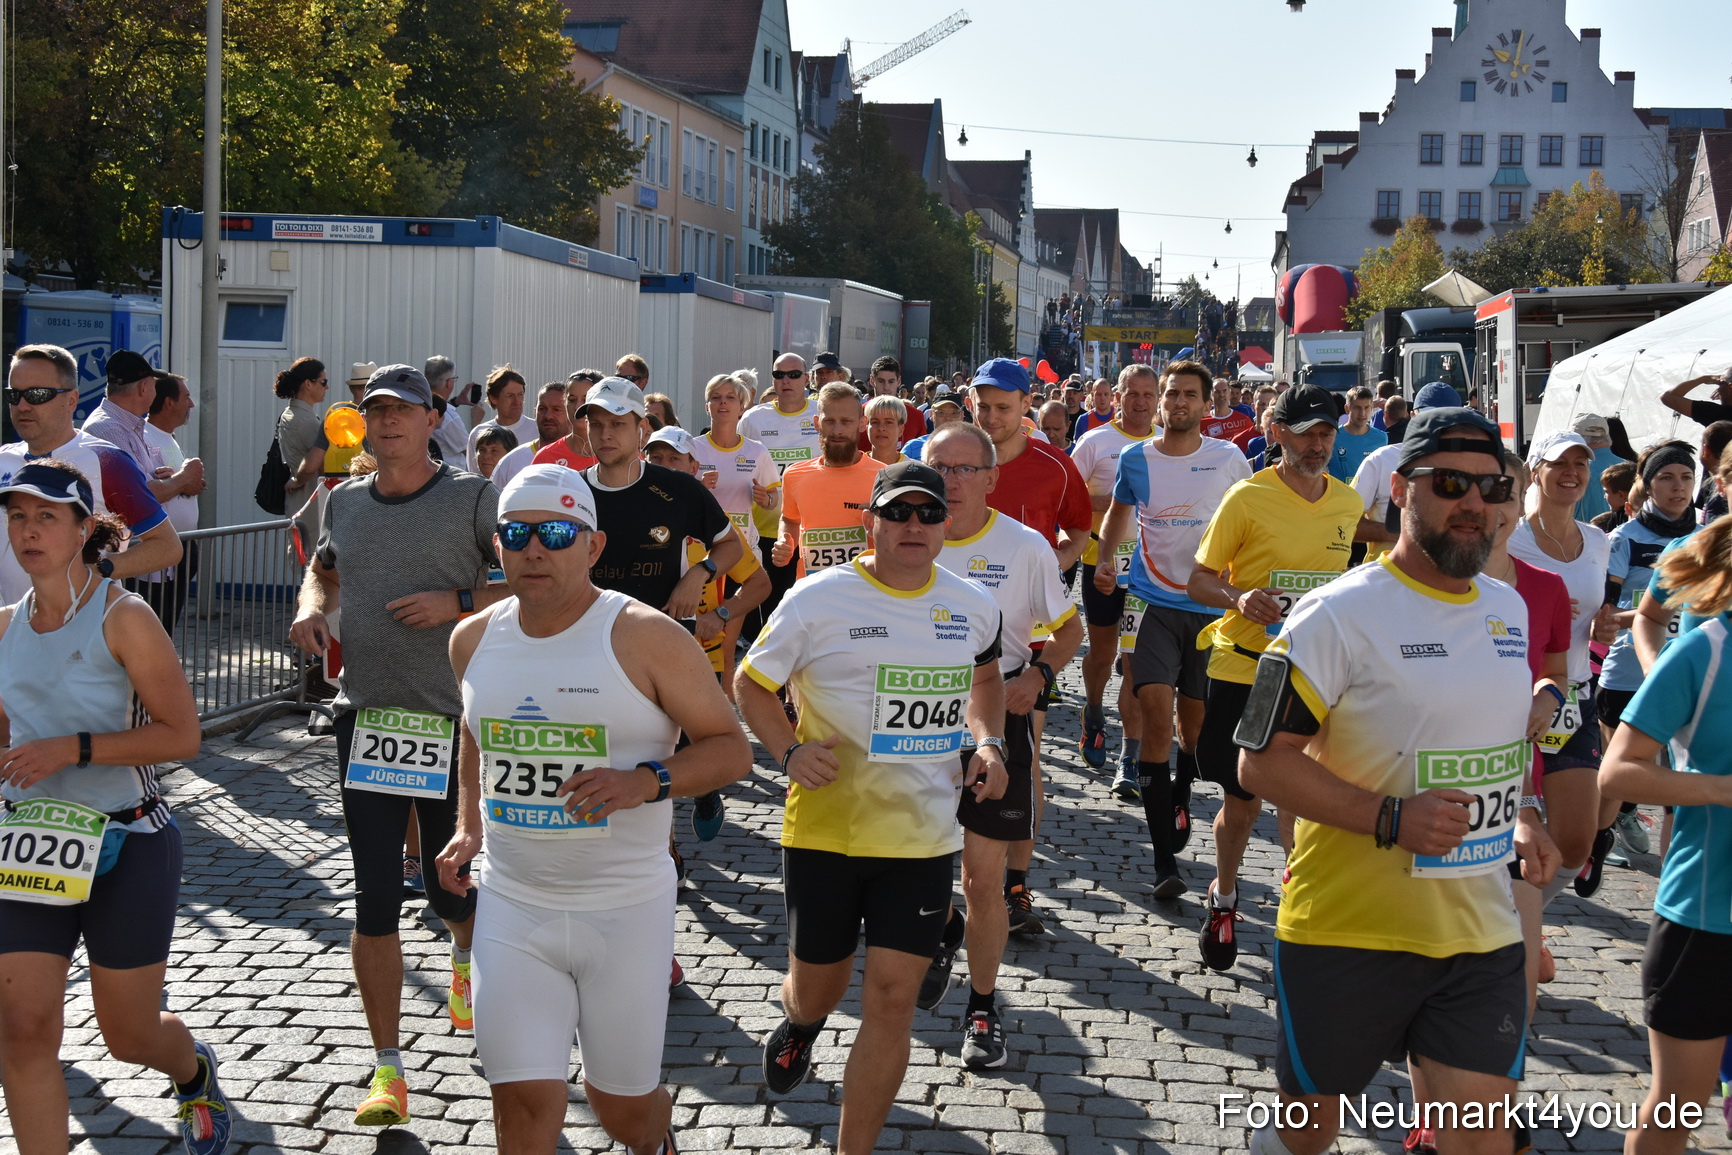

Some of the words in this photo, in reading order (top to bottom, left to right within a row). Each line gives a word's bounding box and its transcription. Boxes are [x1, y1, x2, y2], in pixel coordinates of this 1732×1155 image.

[47, 317, 71, 327] 08141
[77, 318, 92, 328] 536
[93, 319, 104, 329] 80
[1120, 330, 1160, 340] START
[843, 502, 859, 510] THU
[1171, 518, 1203, 528] Energie
[806, 528, 862, 545] BOCK
[630, 562, 663, 577] 2011
[969, 559, 987, 570] 20
[968, 571, 1009, 580] Neumarkter
[932, 608, 951, 622] 20
[849, 626, 889, 636] BOCK
[1487, 620, 1508, 636] 20
[935, 632, 967, 642] Stadtlauf
[1400, 643, 1448, 655] BOCK
[884, 667, 969, 692] BOCK
[364, 707, 445, 736] BOCK
[886, 698, 962, 730] 2048
[1550, 706, 1575, 730] 76
[488, 723, 598, 752] BOCK
[891, 736, 952, 752] JÜRGEN
[362, 734, 440, 768] 2025
[1428, 743, 1521, 784] BOCK
[366, 768, 428, 787] JÜRGEN
[1462, 785, 1517, 832] 026
[7, 802, 98, 832] BOCK
[0, 831, 85, 870] 1020
[1441, 837, 1508, 863] MARKUS
